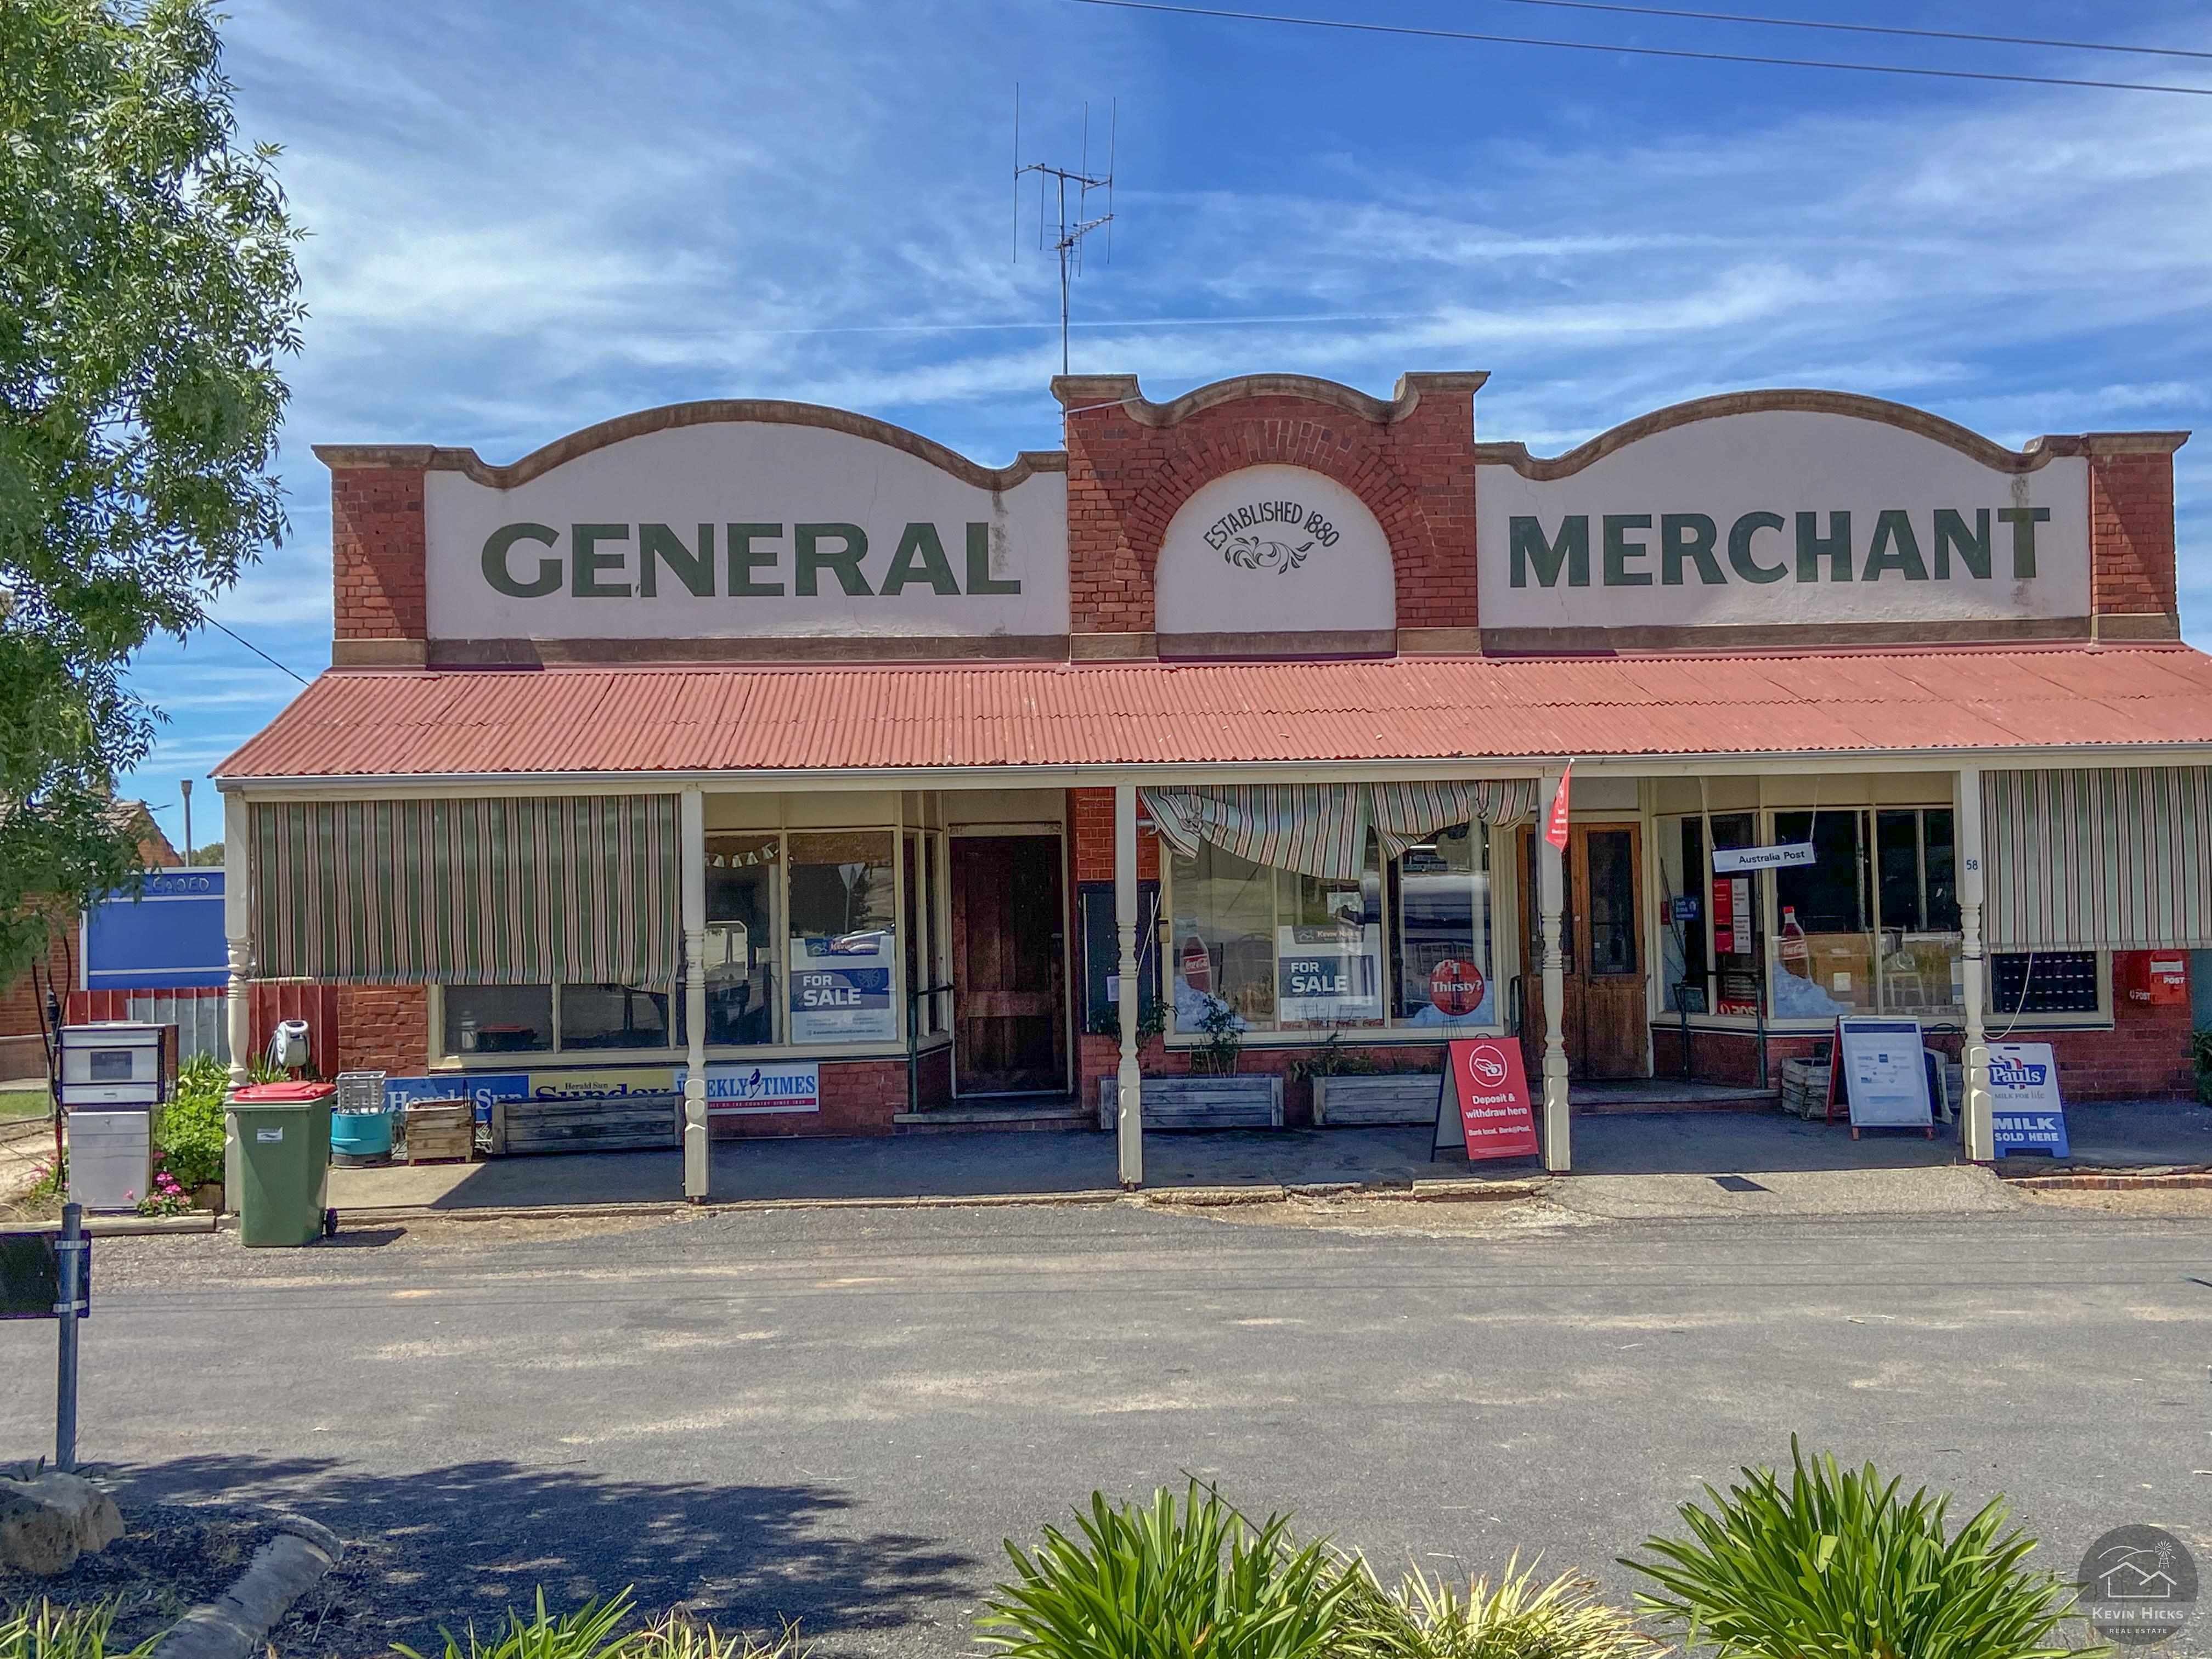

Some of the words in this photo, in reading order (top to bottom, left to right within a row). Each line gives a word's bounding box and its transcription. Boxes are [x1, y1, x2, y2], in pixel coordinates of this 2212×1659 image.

[1203, 500, 1303, 551] ESTABLISHED
[1303, 510, 1340, 547] 1880
[1508, 507, 2051, 588] MERCHANT
[481, 521, 1021, 599] GENERAL
[1739, 853, 1781, 864] Australia
[1784, 850, 1805, 860] Post
[1966, 859, 1978, 871] 58
[1290, 962, 1319, 973] FOR
[803, 975, 832, 986] FOR
[1291, 975, 1348, 993] SALE
[2163, 976, 2185, 984] POST
[1431, 980, 1482, 994] Thirsty?
[803, 988, 861, 1007] SALE
[2135, 991, 2151, 1001] POST
[1990, 1066, 2041, 1083] Pauls
[763, 1075, 816, 1096] TIMES
[1472, 1093, 1508, 1105] Deposit
[1509, 1093, 1515, 1102] &
[2030, 1090, 2045, 1099] life
[1465, 1108, 1506, 1119] withdraw
[1507, 1107, 1528, 1116] here
[1993, 1118, 2057, 1130] MILK
[1994, 1132, 2025, 1142] SOLD
[2029, 1132, 2059, 1142] HERE
